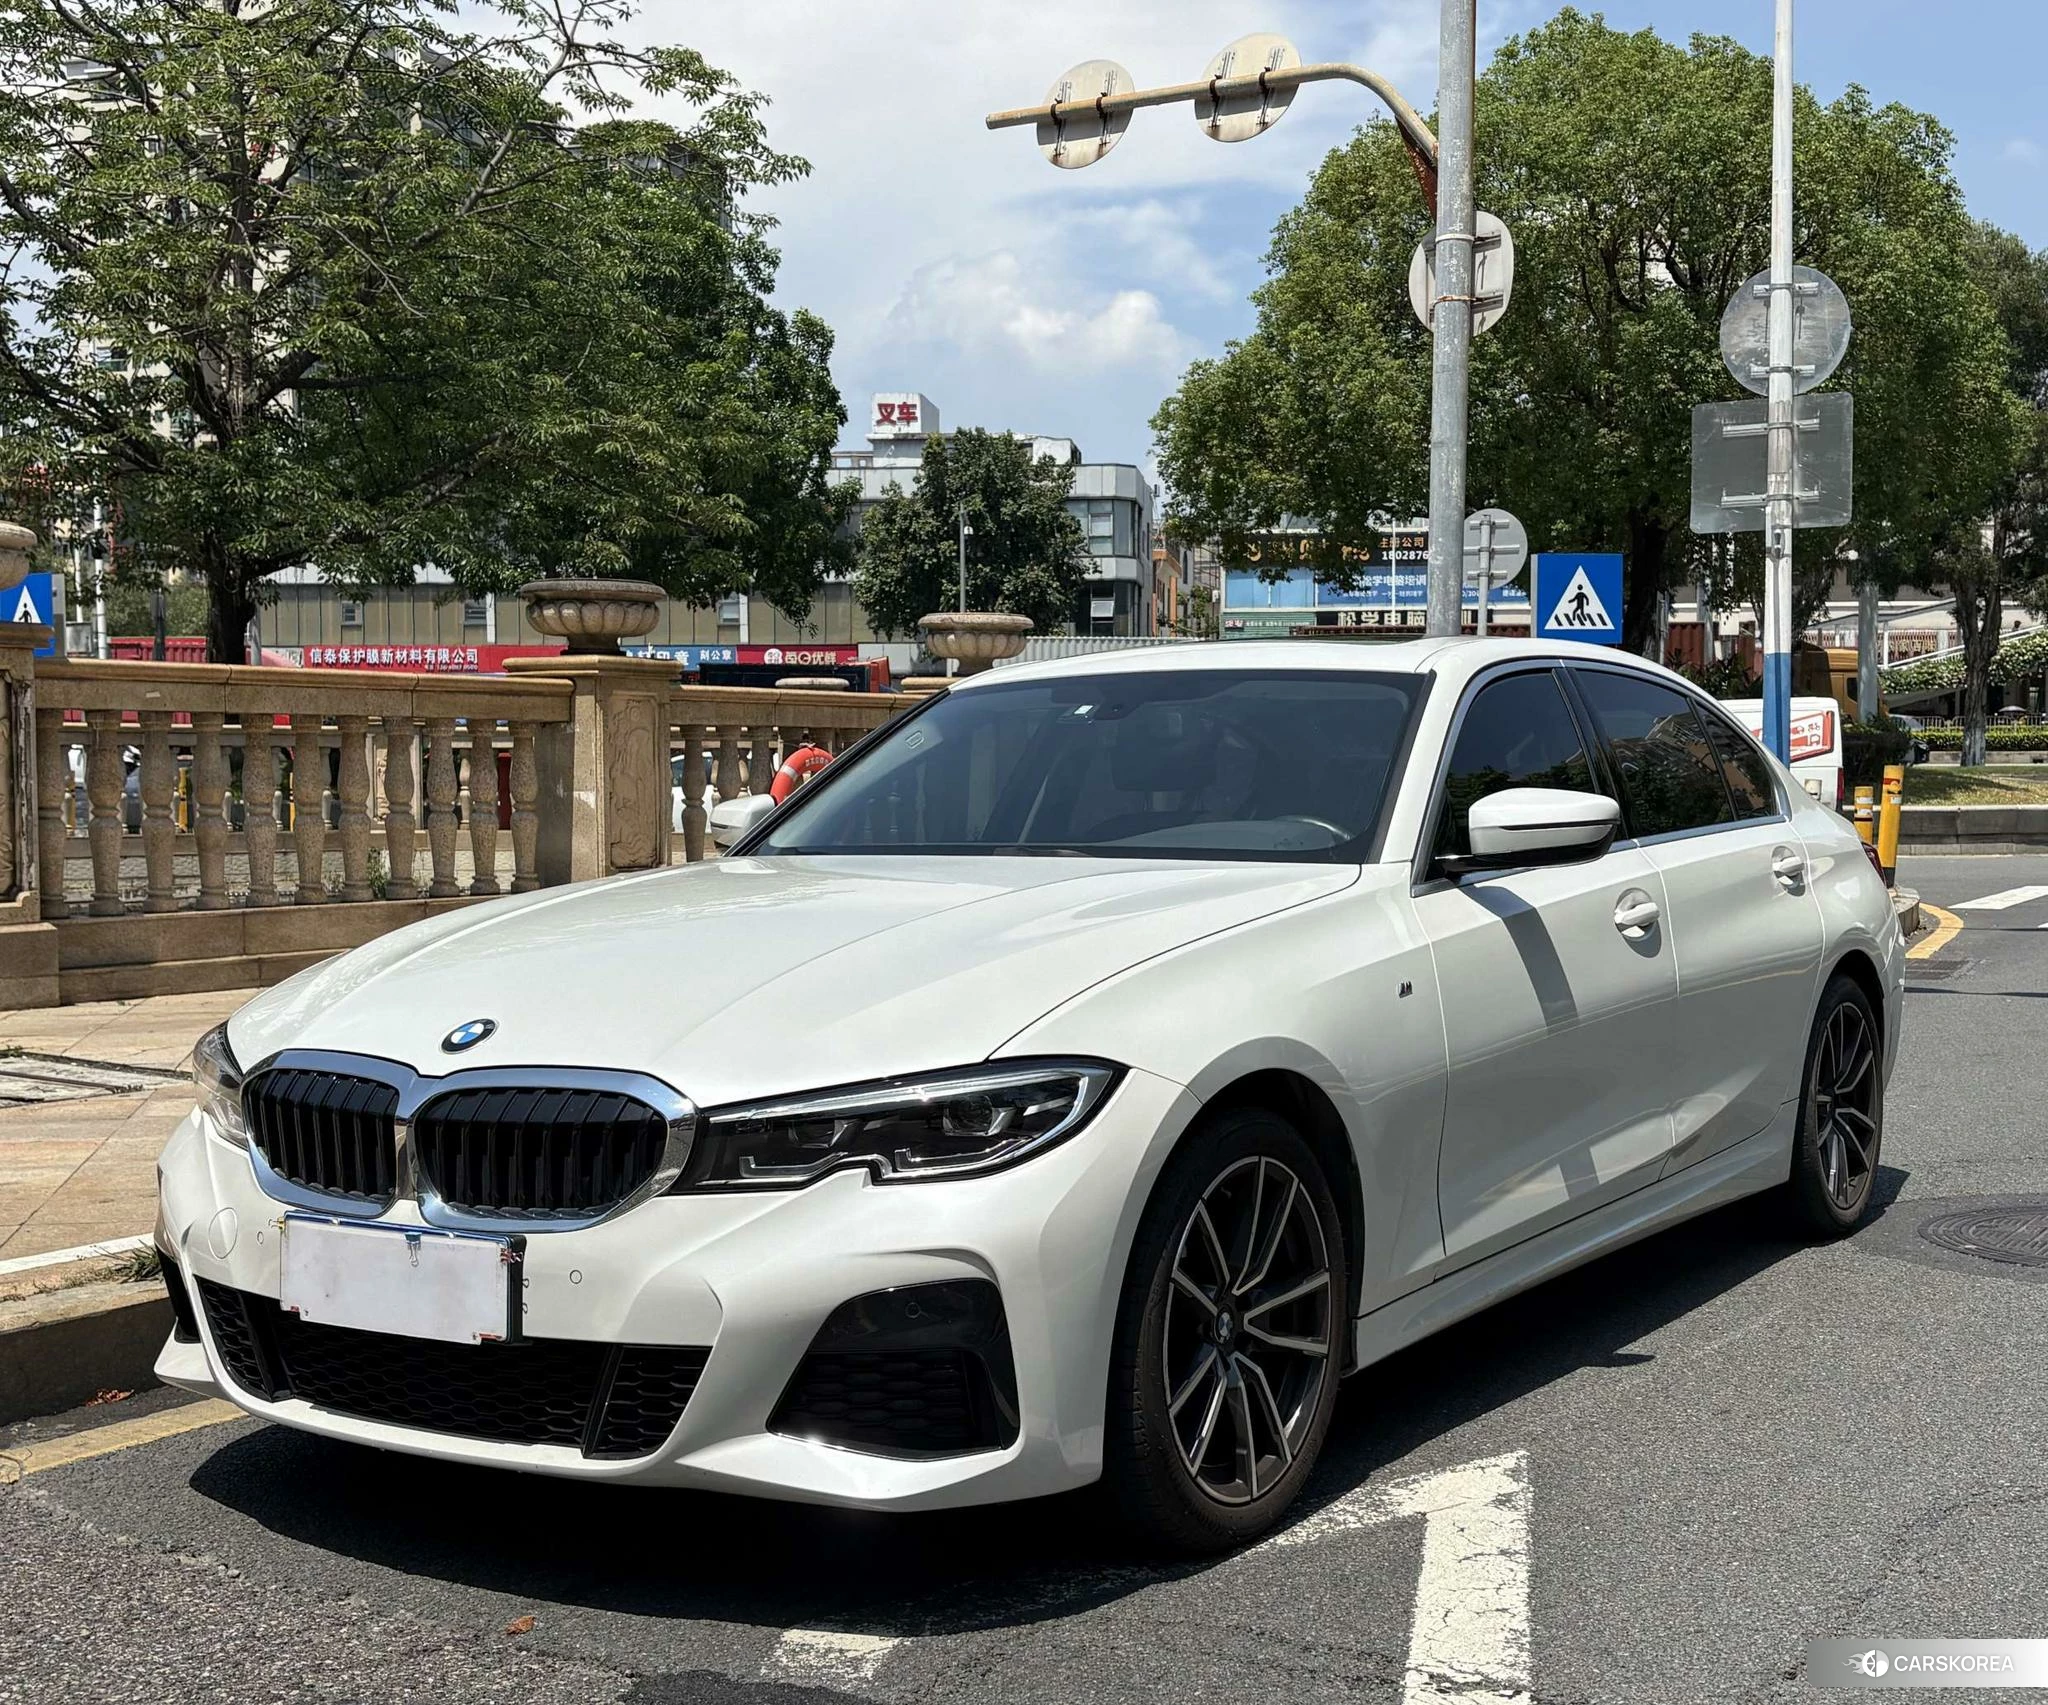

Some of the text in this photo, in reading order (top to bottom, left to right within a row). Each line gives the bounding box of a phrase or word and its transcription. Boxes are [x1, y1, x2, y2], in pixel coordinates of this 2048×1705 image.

[876, 402, 918, 427] 叉车
[310, 648, 479, 665] 信泰保护膜新材料有限公司
